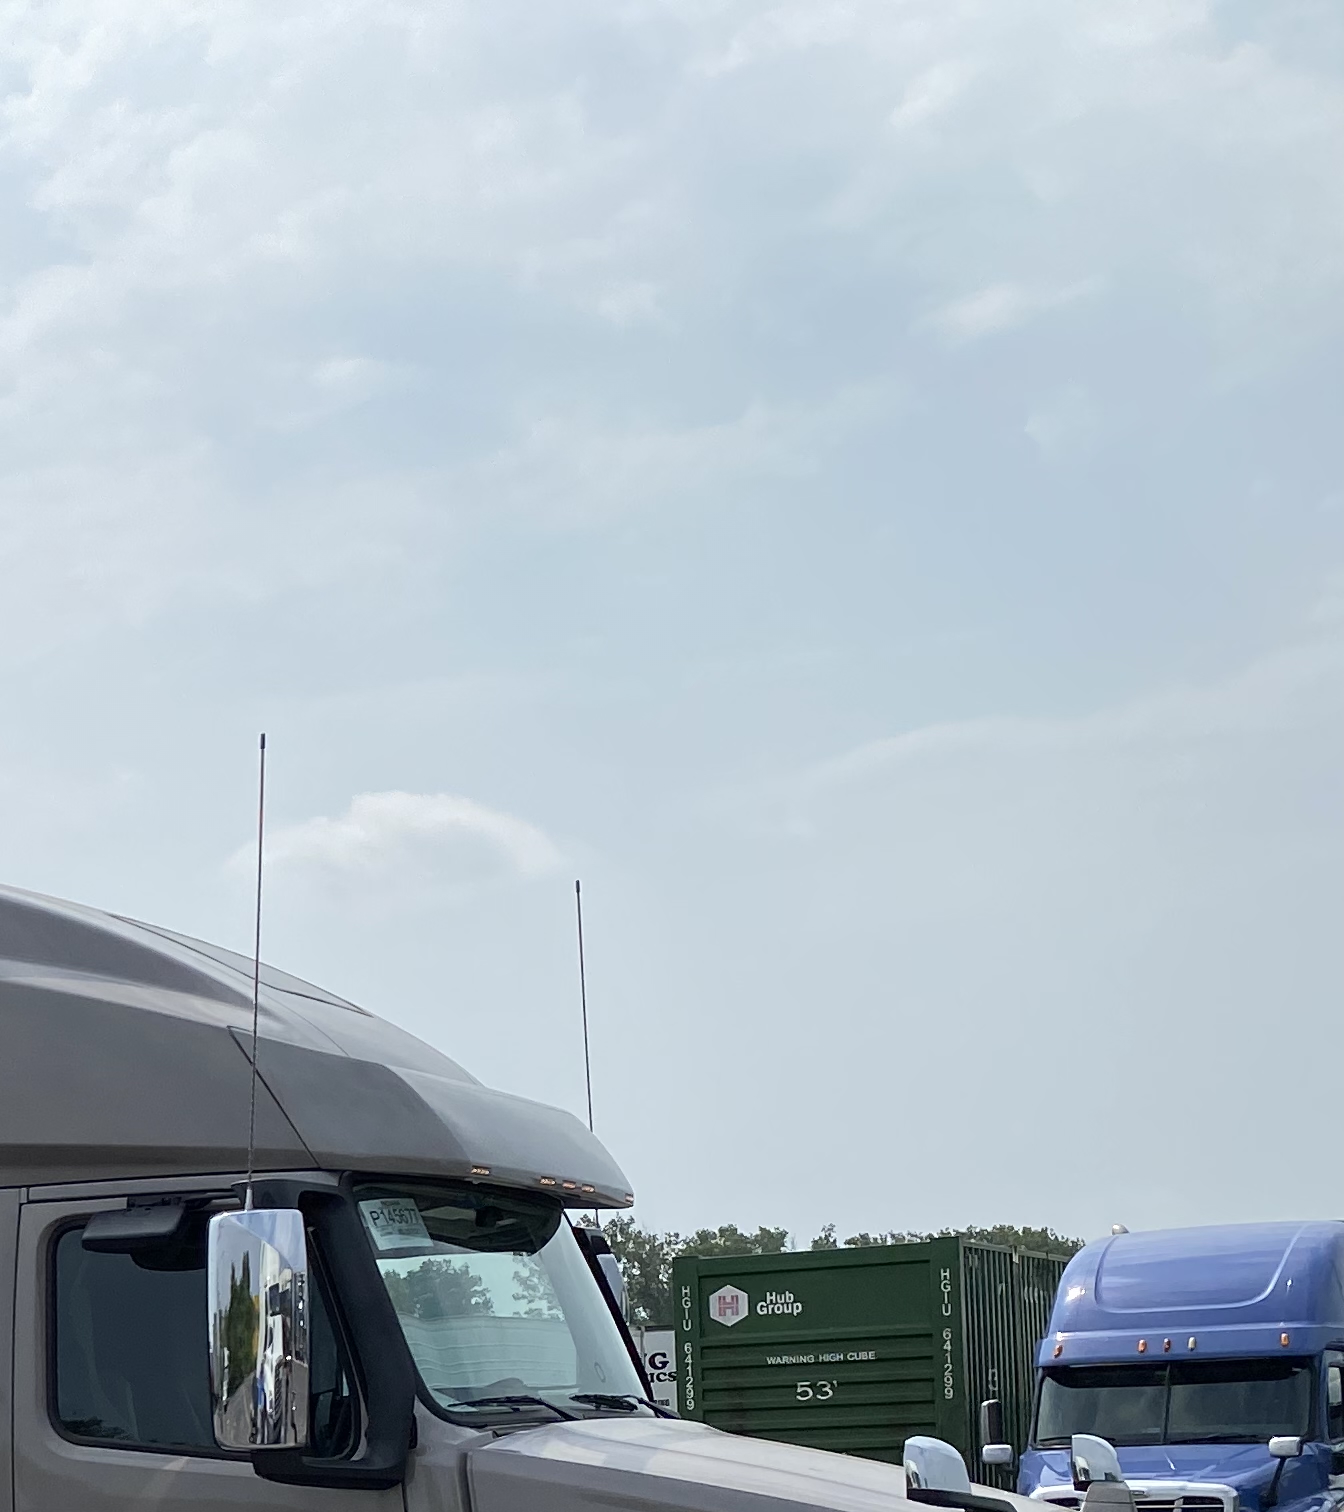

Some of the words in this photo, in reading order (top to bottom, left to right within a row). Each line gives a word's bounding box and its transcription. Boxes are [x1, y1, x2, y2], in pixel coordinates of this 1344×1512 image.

[681, 1285, 692, 1331] HGIU
[756, 1302, 803, 1317] Group
[766, 1291, 795, 1304] Hub
[940, 1267, 952, 1316] HGIU
[684, 1342, 695, 1411] 641299
[766, 1354, 815, 1365] WARNING
[818, 1352, 844, 1362] HIGH
[846, 1350, 876, 1361] CUBE
[942, 1327, 954, 1400] 641299
